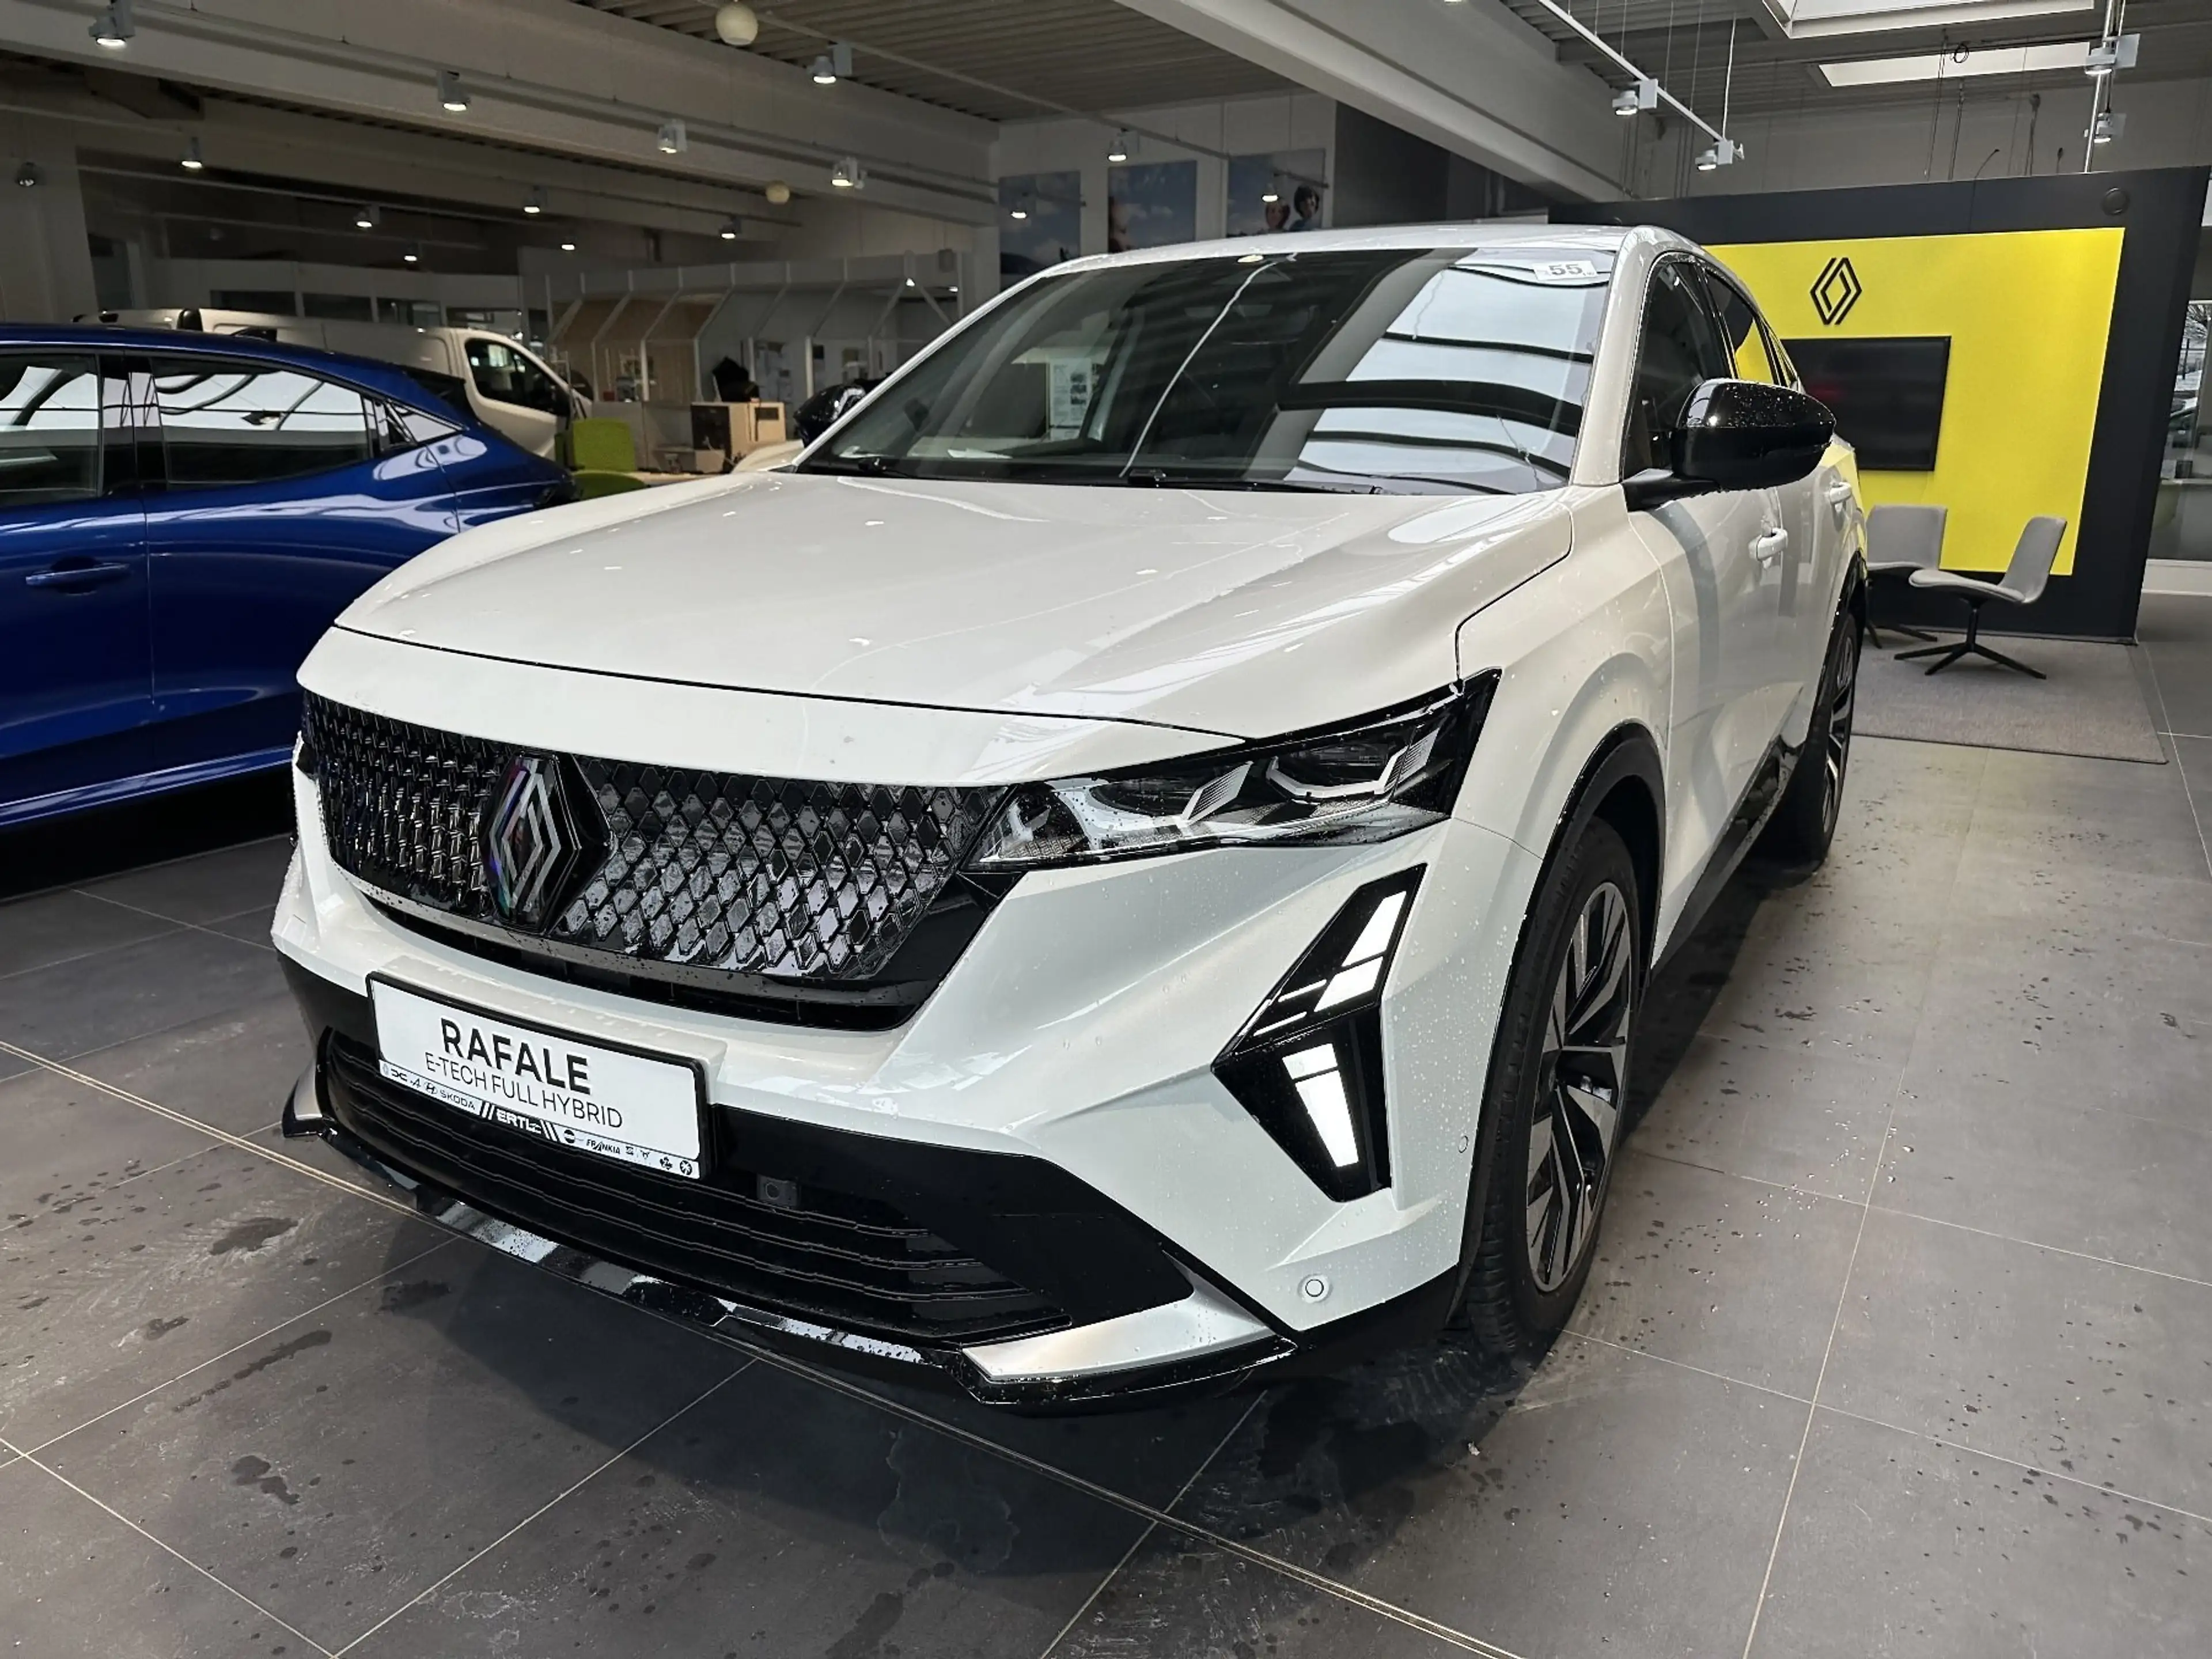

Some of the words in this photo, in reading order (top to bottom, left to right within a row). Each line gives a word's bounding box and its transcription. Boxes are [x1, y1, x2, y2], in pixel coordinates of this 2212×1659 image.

[425, 1052, 487, 1090] E-TECH
[491, 1074, 538, 1106] FULL
[542, 1090, 623, 1128] HYBRID
[441, 1018, 591, 1095] RAFALE
[586, 1139, 620, 1154] FRANKIA
